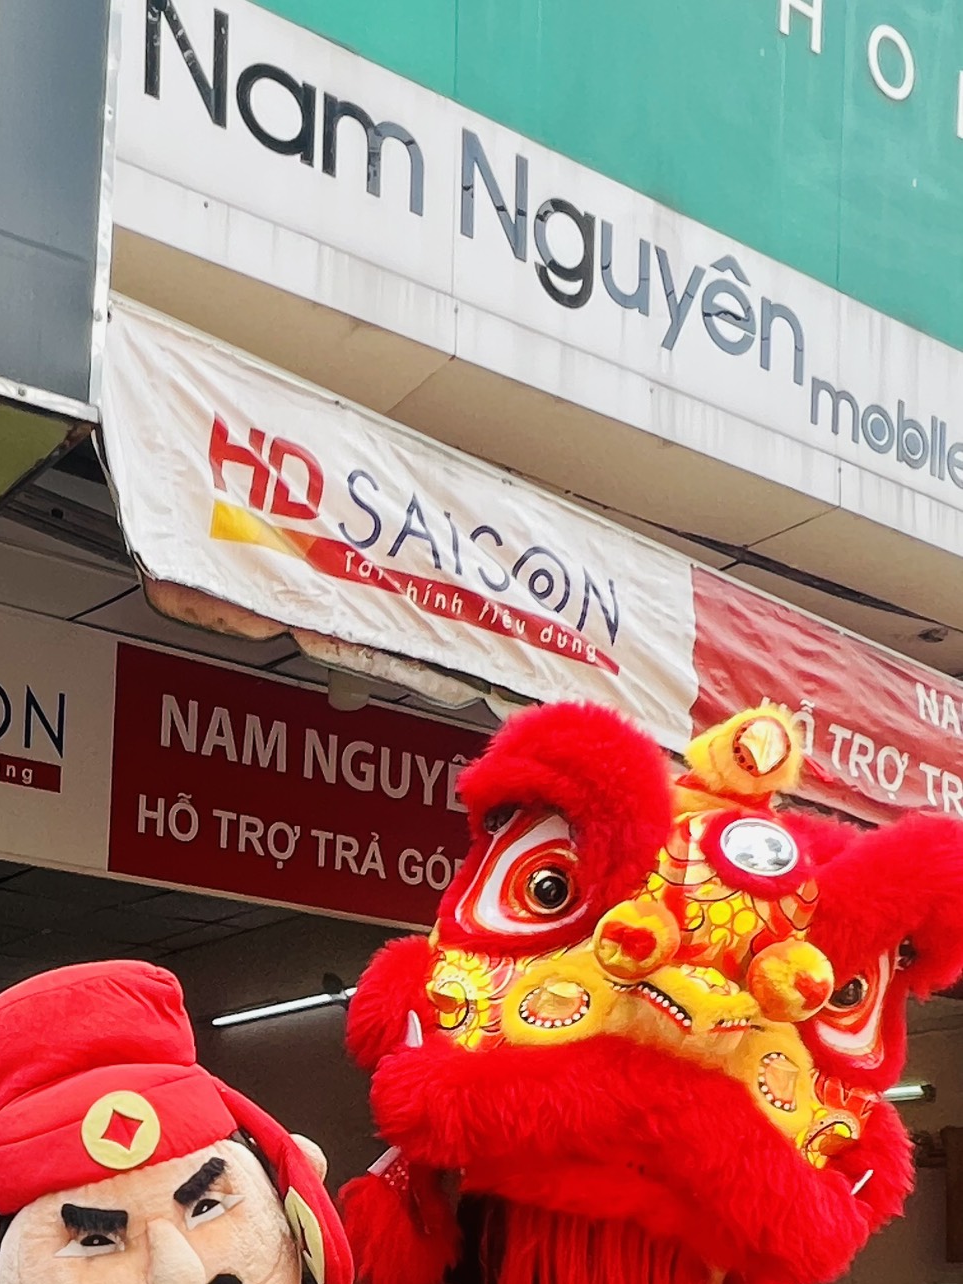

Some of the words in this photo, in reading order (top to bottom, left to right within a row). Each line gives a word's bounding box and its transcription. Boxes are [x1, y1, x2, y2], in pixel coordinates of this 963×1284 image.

[779, 0, 963, 139] HO
[144, 0, 425, 218] Nam
[461, 127, 805, 387] Nguyên
[208, 411, 324, 520] HD
[338, 469, 621, 647] SAISON
[160, 694, 287, 774] NAM
[302, 728, 471, 813] NGUYÊ
[915, 682, 963, 735] NA
[828, 723, 909, 800] TRỢ
[919, 762, 963, 817] TR
[137, 792, 199, 842] HỖ
[212, 809, 301, 869] TRỢ
[311, 829, 386, 879] TRẢ
